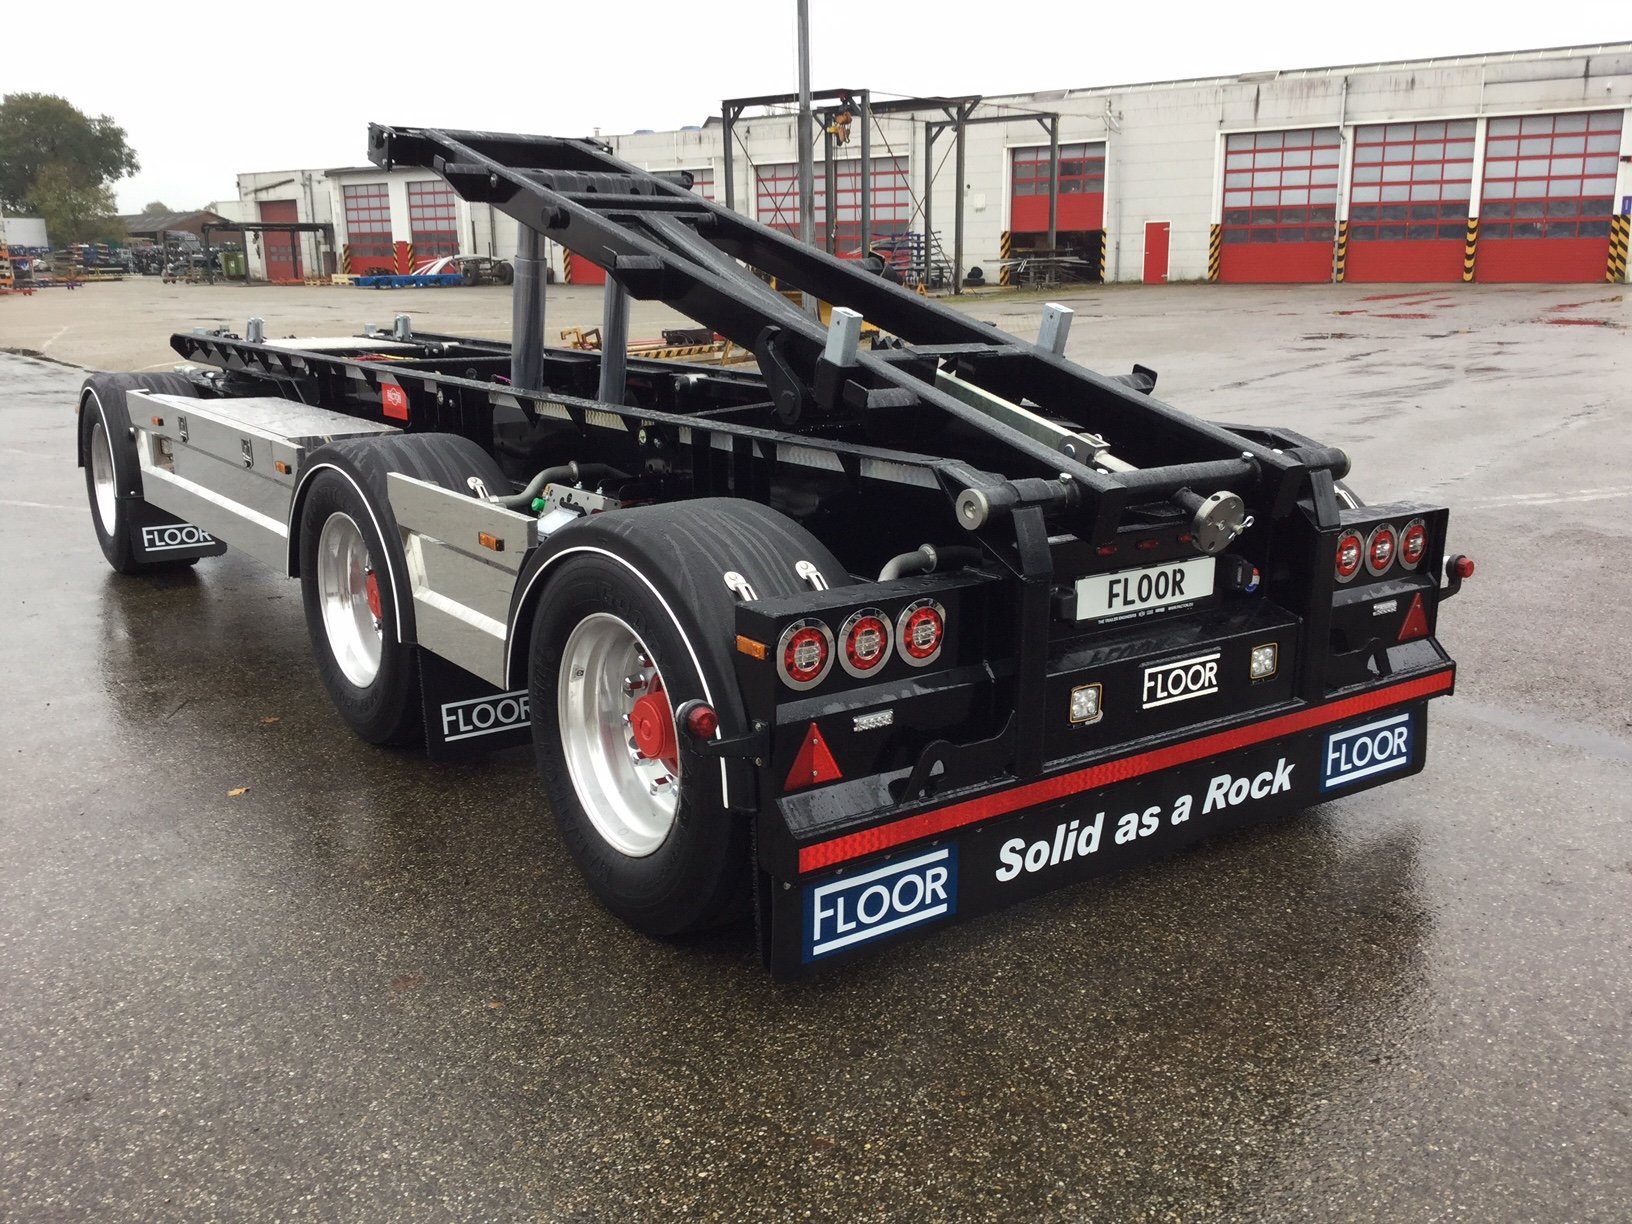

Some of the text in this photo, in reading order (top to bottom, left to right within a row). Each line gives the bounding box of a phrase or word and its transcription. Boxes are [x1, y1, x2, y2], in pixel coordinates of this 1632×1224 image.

[142, 527, 212, 547] FLOOR
[1108, 568, 1185, 609] FLOOR
[1142, 662, 1218, 702] FLOOR
[1326, 726, 1408, 776] FLOOR
[995, 757, 1295, 882] Solid as a Rock
[813, 866, 948, 941] FLOOR
